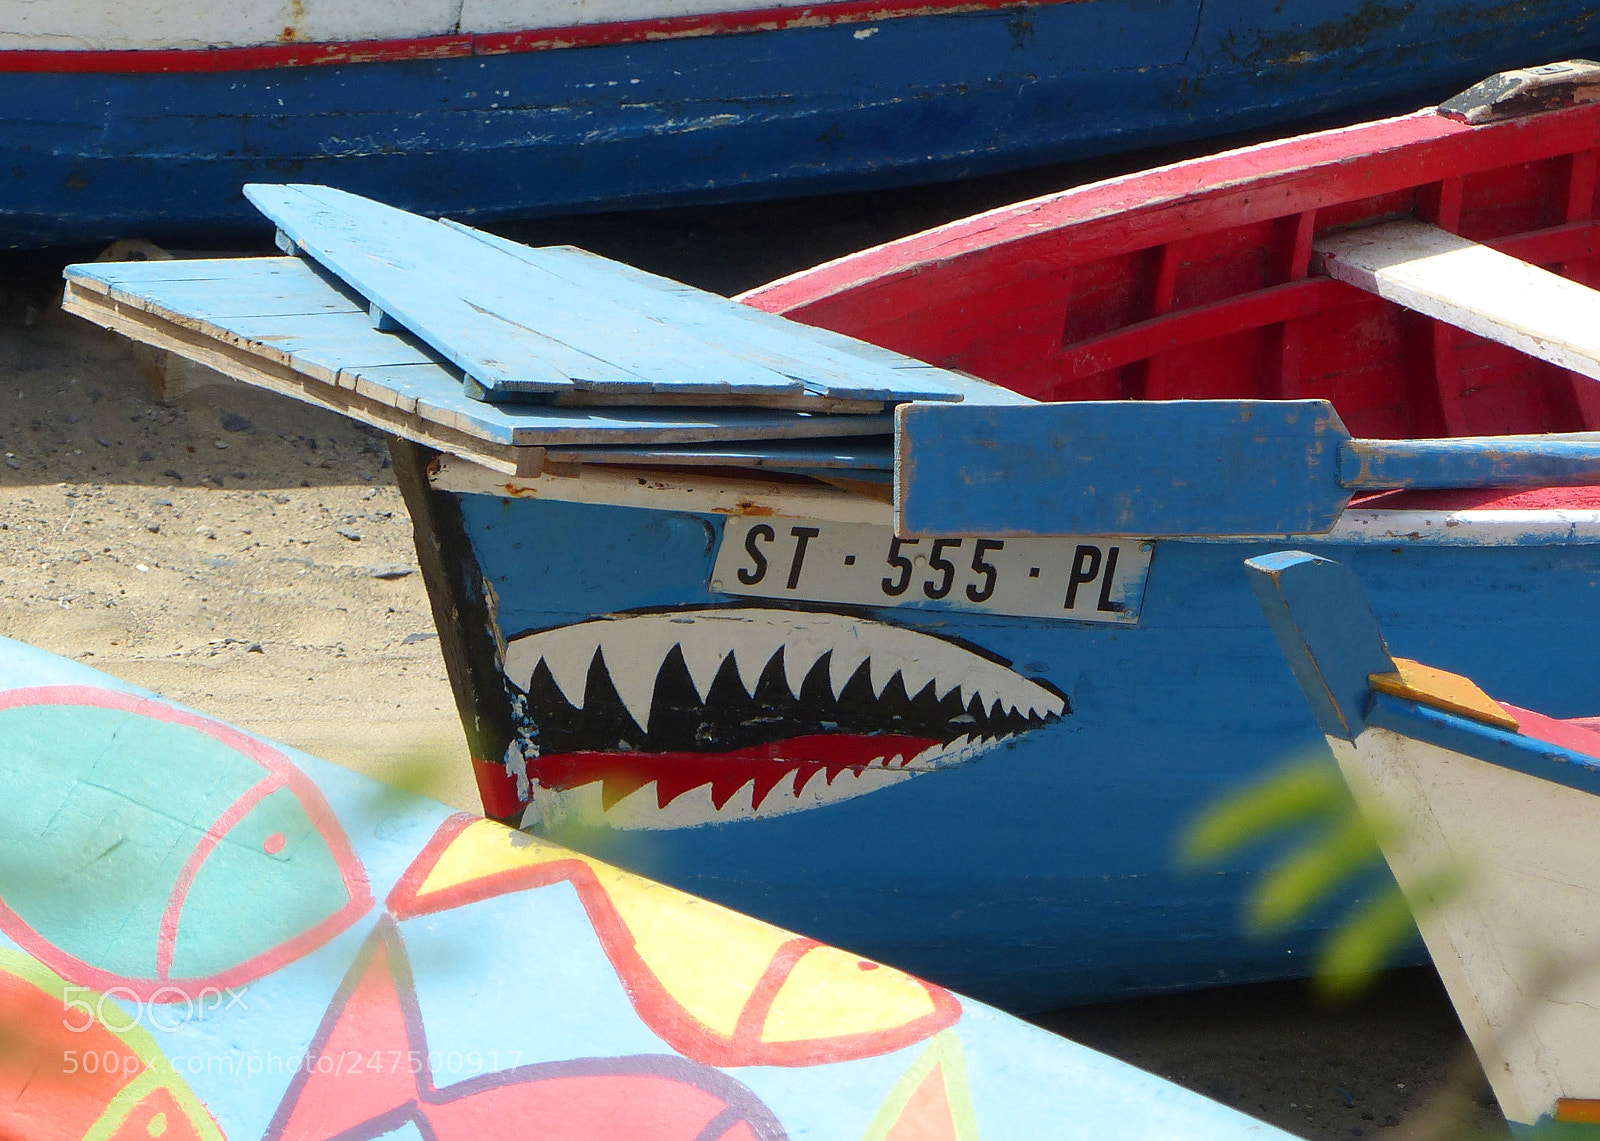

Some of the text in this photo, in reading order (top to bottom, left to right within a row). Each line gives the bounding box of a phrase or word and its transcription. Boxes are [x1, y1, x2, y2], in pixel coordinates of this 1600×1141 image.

[737, 524, 819, 589] ST
[881, 538, 1005, 602] 555
[1063, 545, 1126, 612] PL
